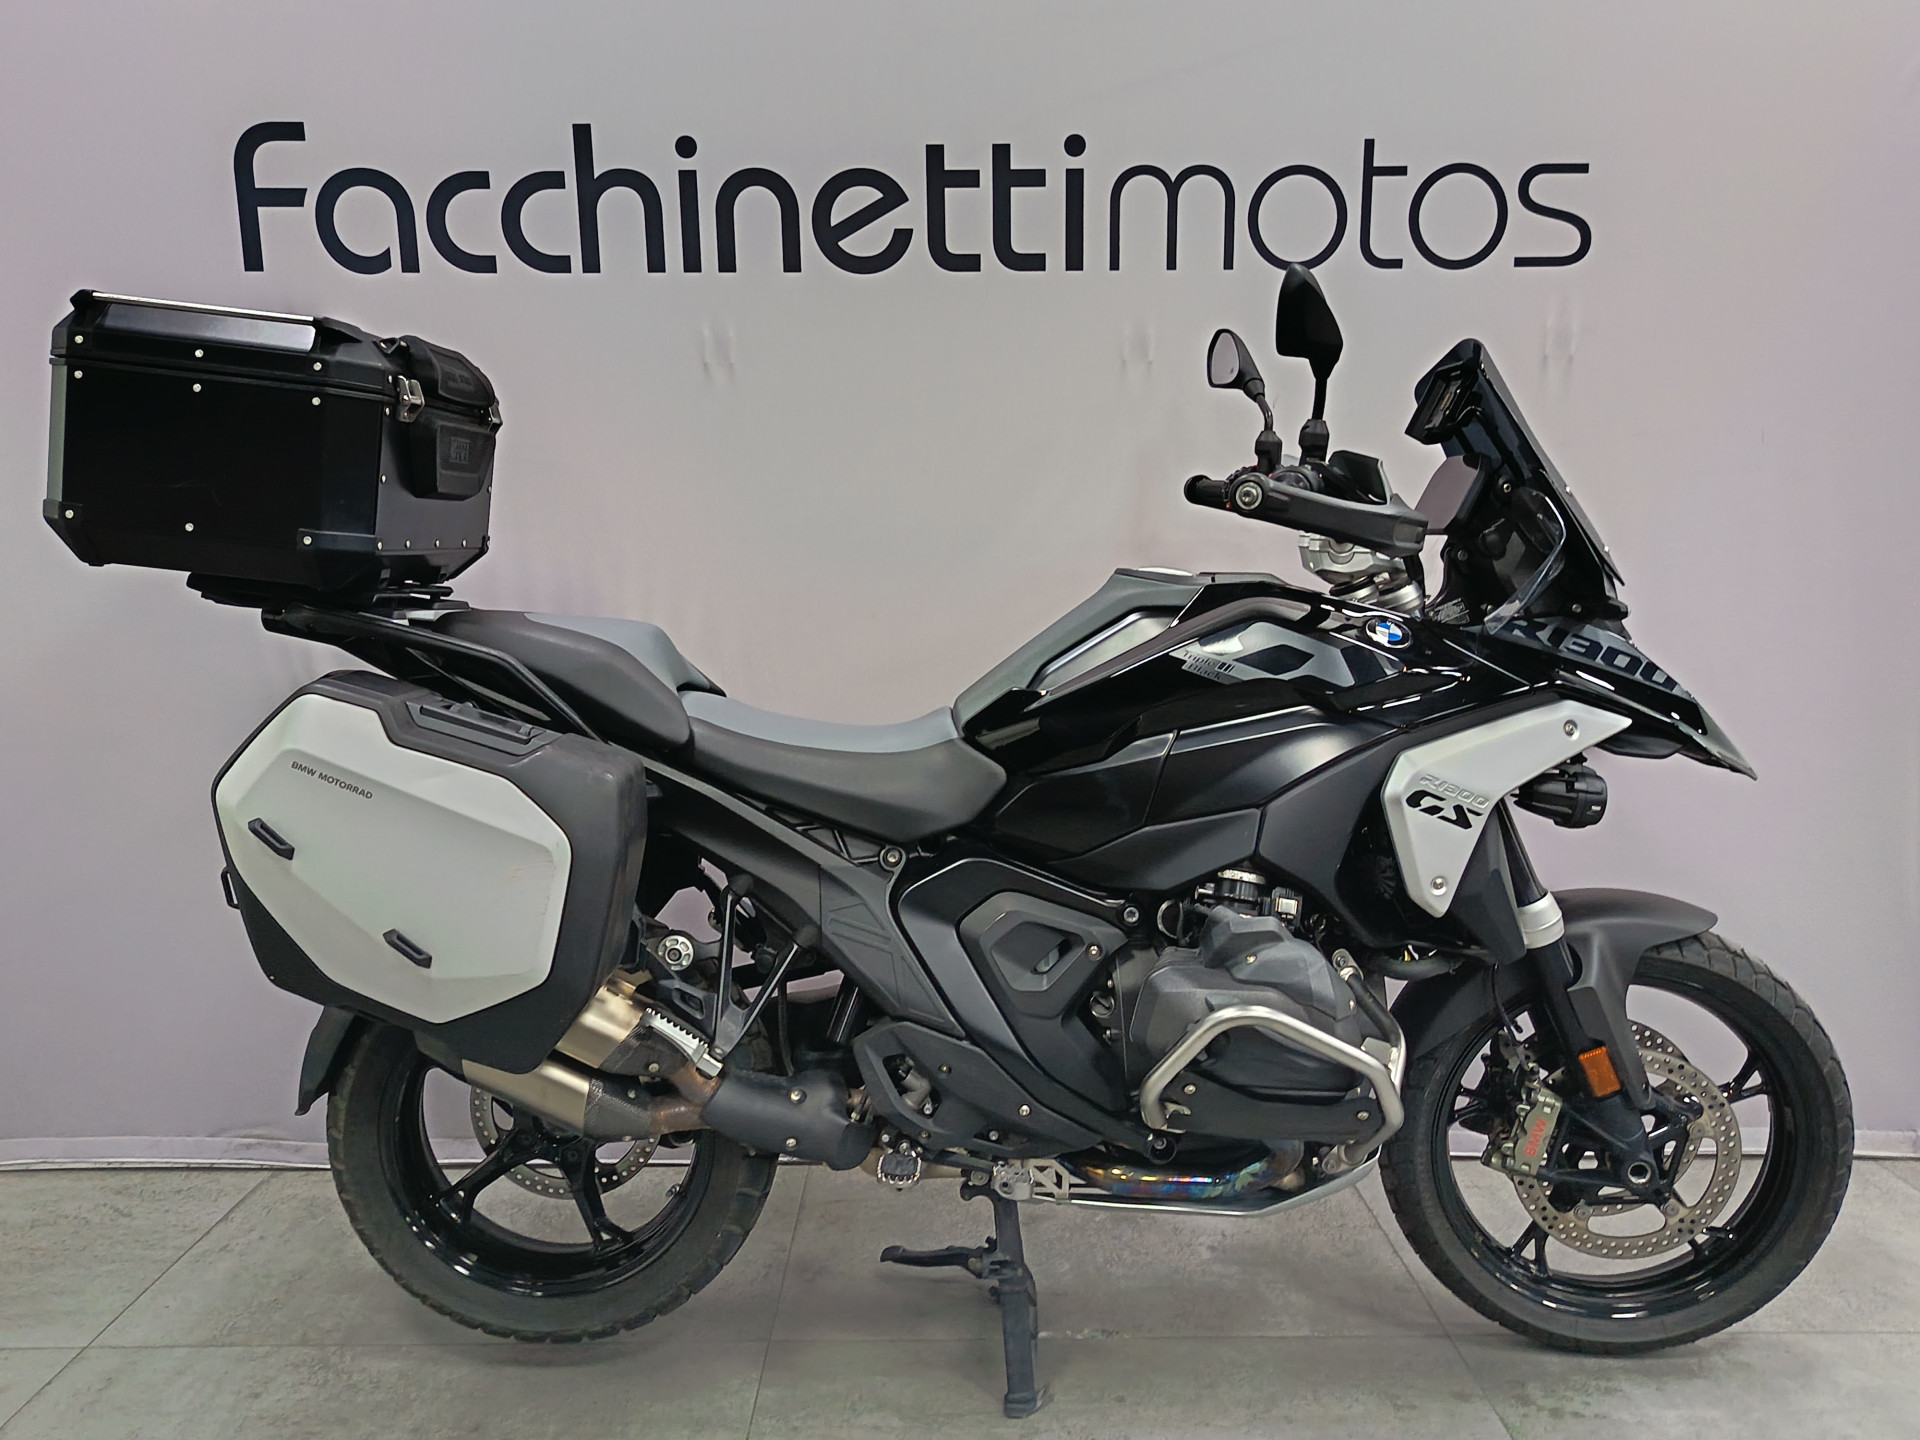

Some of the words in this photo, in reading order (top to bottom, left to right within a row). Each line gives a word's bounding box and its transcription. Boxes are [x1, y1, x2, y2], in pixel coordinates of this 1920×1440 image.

[291, 761, 317, 777] BMW
[318, 772, 373, 799] MOTORRAD
[1420, 773, 1490, 810] R1300
[1405, 789, 1484, 830] GS
